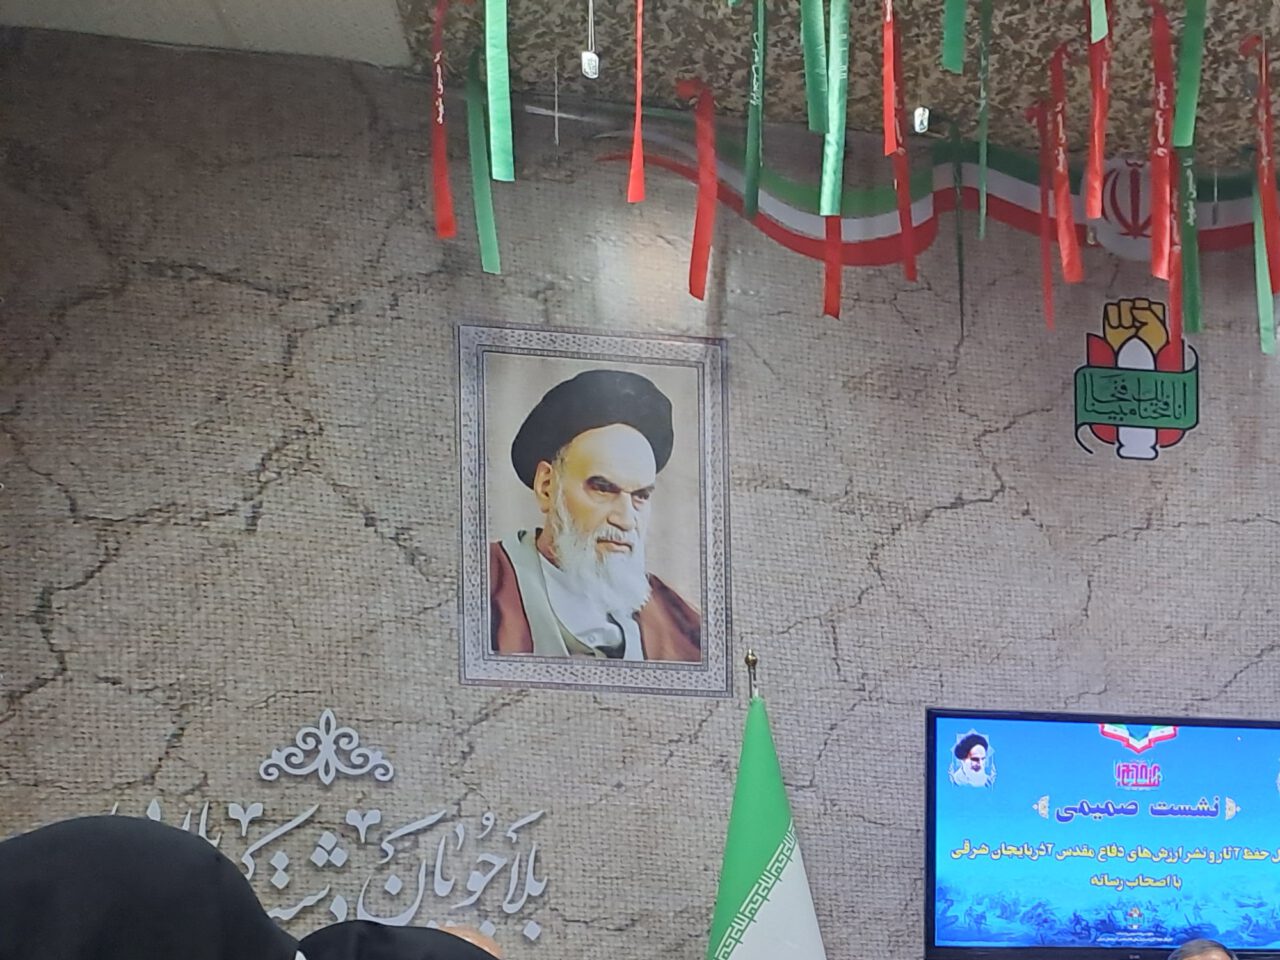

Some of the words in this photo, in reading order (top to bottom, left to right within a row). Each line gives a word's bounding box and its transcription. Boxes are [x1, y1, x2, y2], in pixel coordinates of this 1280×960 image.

[1056, 800, 1139, 822] صمیمی
[1150, 796, 1220, 818] نشست
[951, 839, 989, 859] شرقی
[991, 841, 1055, 860] آذربایجان
[1055, 843, 1094, 860] مقدس
[1097, 844, 1125, 861] دفاع
[1183, 848, 1207, 864] نشر
[1216, 847, 1240, 864] آثار
[1242, 847, 1270, 861] حفظ
[1208, 852, 1216, 864] و
[1090, 873, 1126, 891] رسانه
[1126, 874, 1171, 889] اصحاب
[1172, 875, 1182, 890] با
